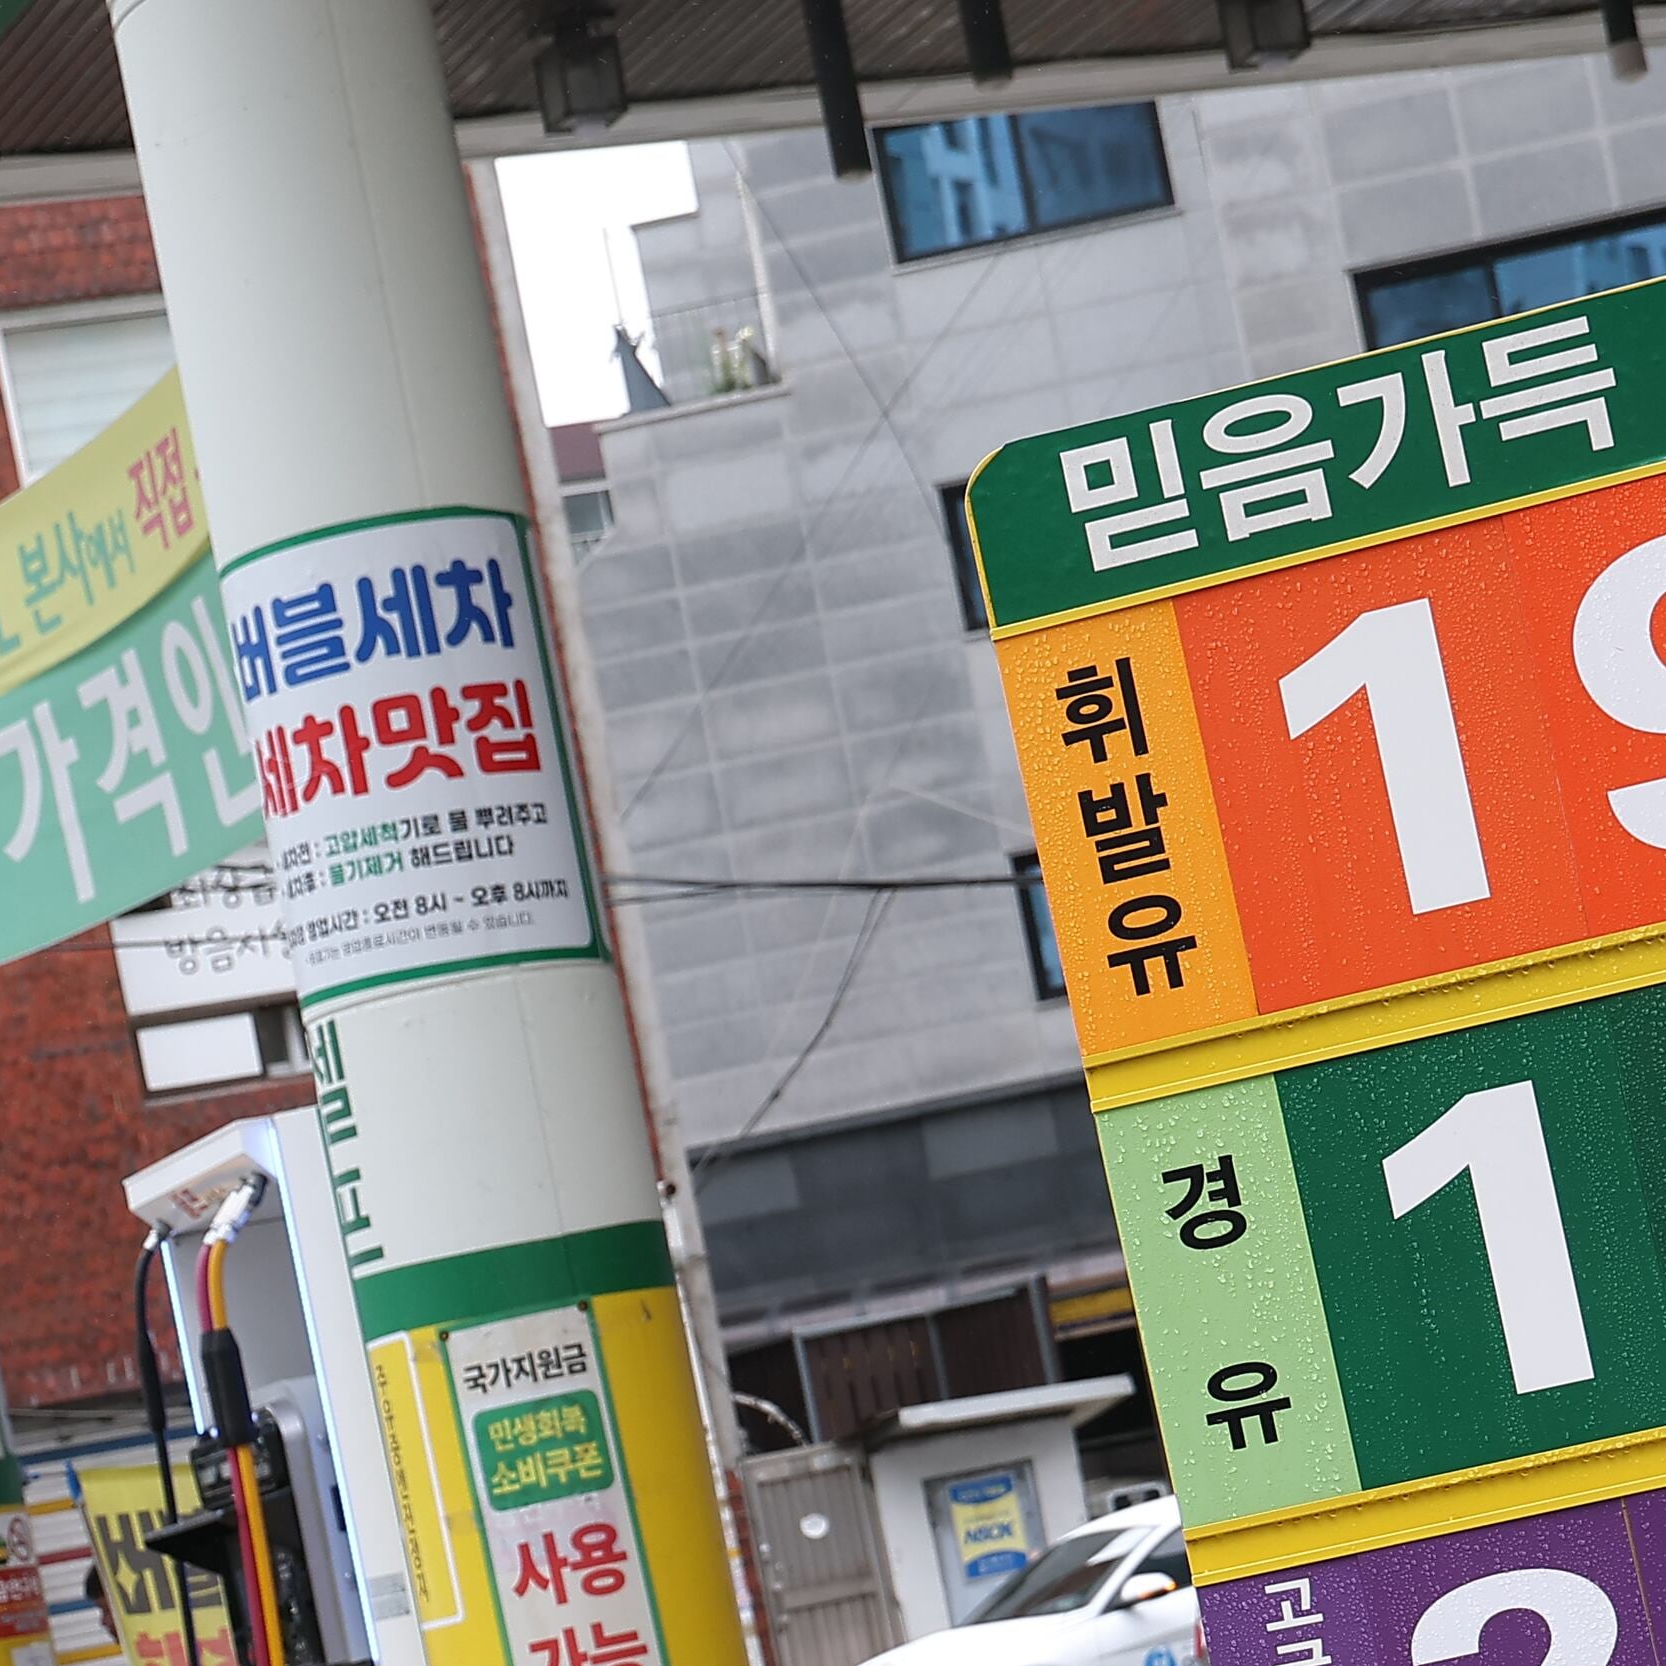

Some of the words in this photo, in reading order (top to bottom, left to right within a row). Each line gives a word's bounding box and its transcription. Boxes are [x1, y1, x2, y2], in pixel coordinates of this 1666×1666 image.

[1058, 316, 1617, 574] 믿음가득
[19, 510, 135, 636] 본사에서
[127, 426, 195, 551] 직접
[234, 559, 514, 701] 버블세차
[255, 679, 542, 818] 세차맛집
[324, 814, 442, 857] 고압세척기로
[448, 808, 468, 833] 물
[474, 803, 548, 830] 뿌려주고
[329, 851, 404, 886] 물기제거
[410, 834, 515, 868] 해드립니다
[1055, 655, 1198, 998] 휘발유
[374, 898, 410, 924] 오전
[414, 892, 448, 917] 8시
[471, 883, 506, 908] 오후
[512, 878, 569, 903] 8시까지
[1162, 1154, 1292, 1452] 경유
[462, 1343, 588, 1395] 국가지원금
[488, 1405, 587, 1454] 민생회복
[490, 1446, 606, 1497] 소비쿠폰
[511, 1522, 629, 1606] 사용
